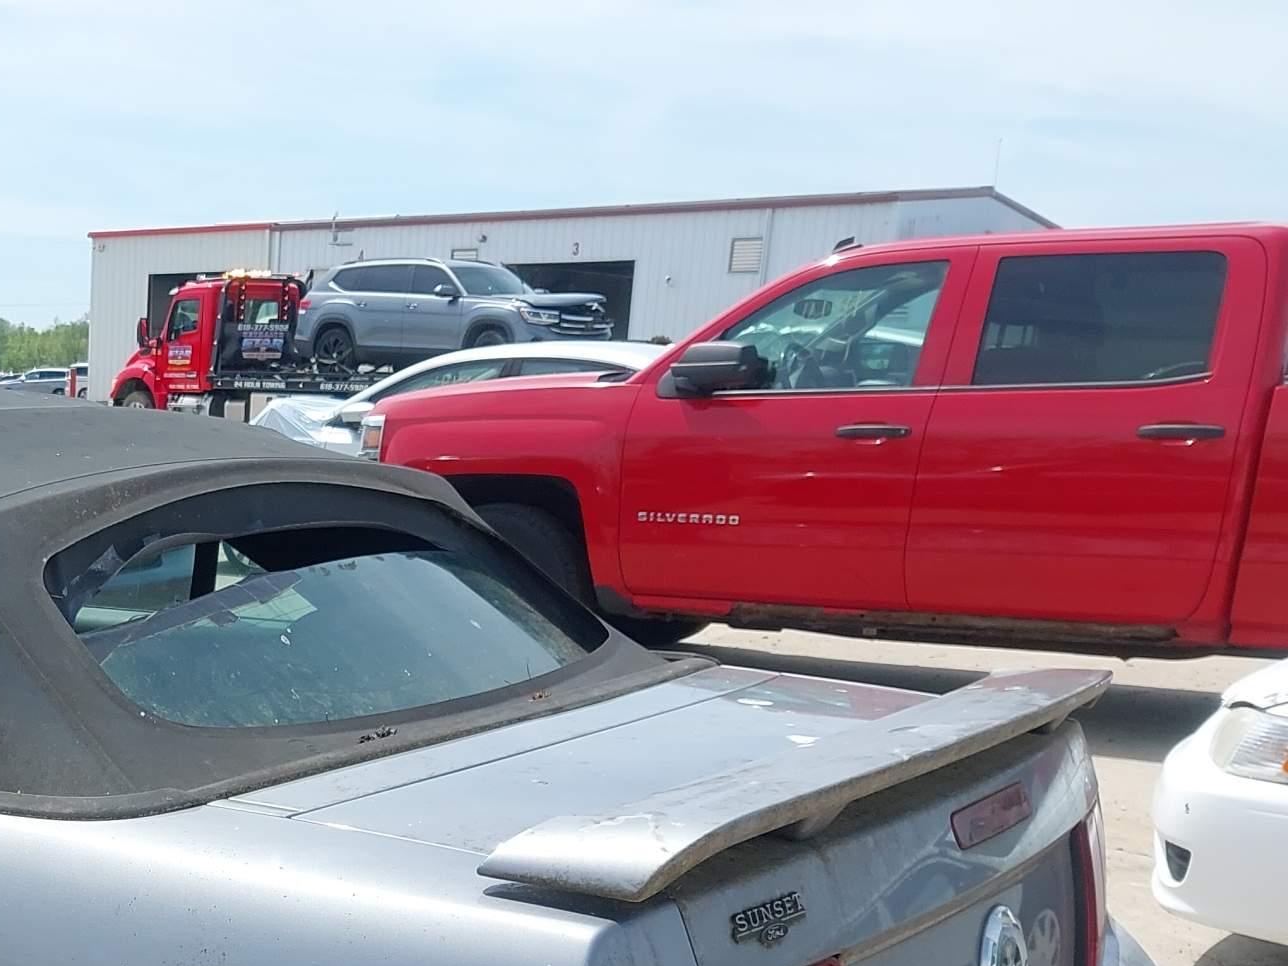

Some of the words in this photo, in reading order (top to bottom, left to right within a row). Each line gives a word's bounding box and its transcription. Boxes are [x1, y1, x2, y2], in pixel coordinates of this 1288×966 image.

[572, 243, 580, 256] 3
[637, 511, 740, 525] SILVERADO
[735, 892, 803, 932] SUNSET
[767, 926, 785, 940] Ford
